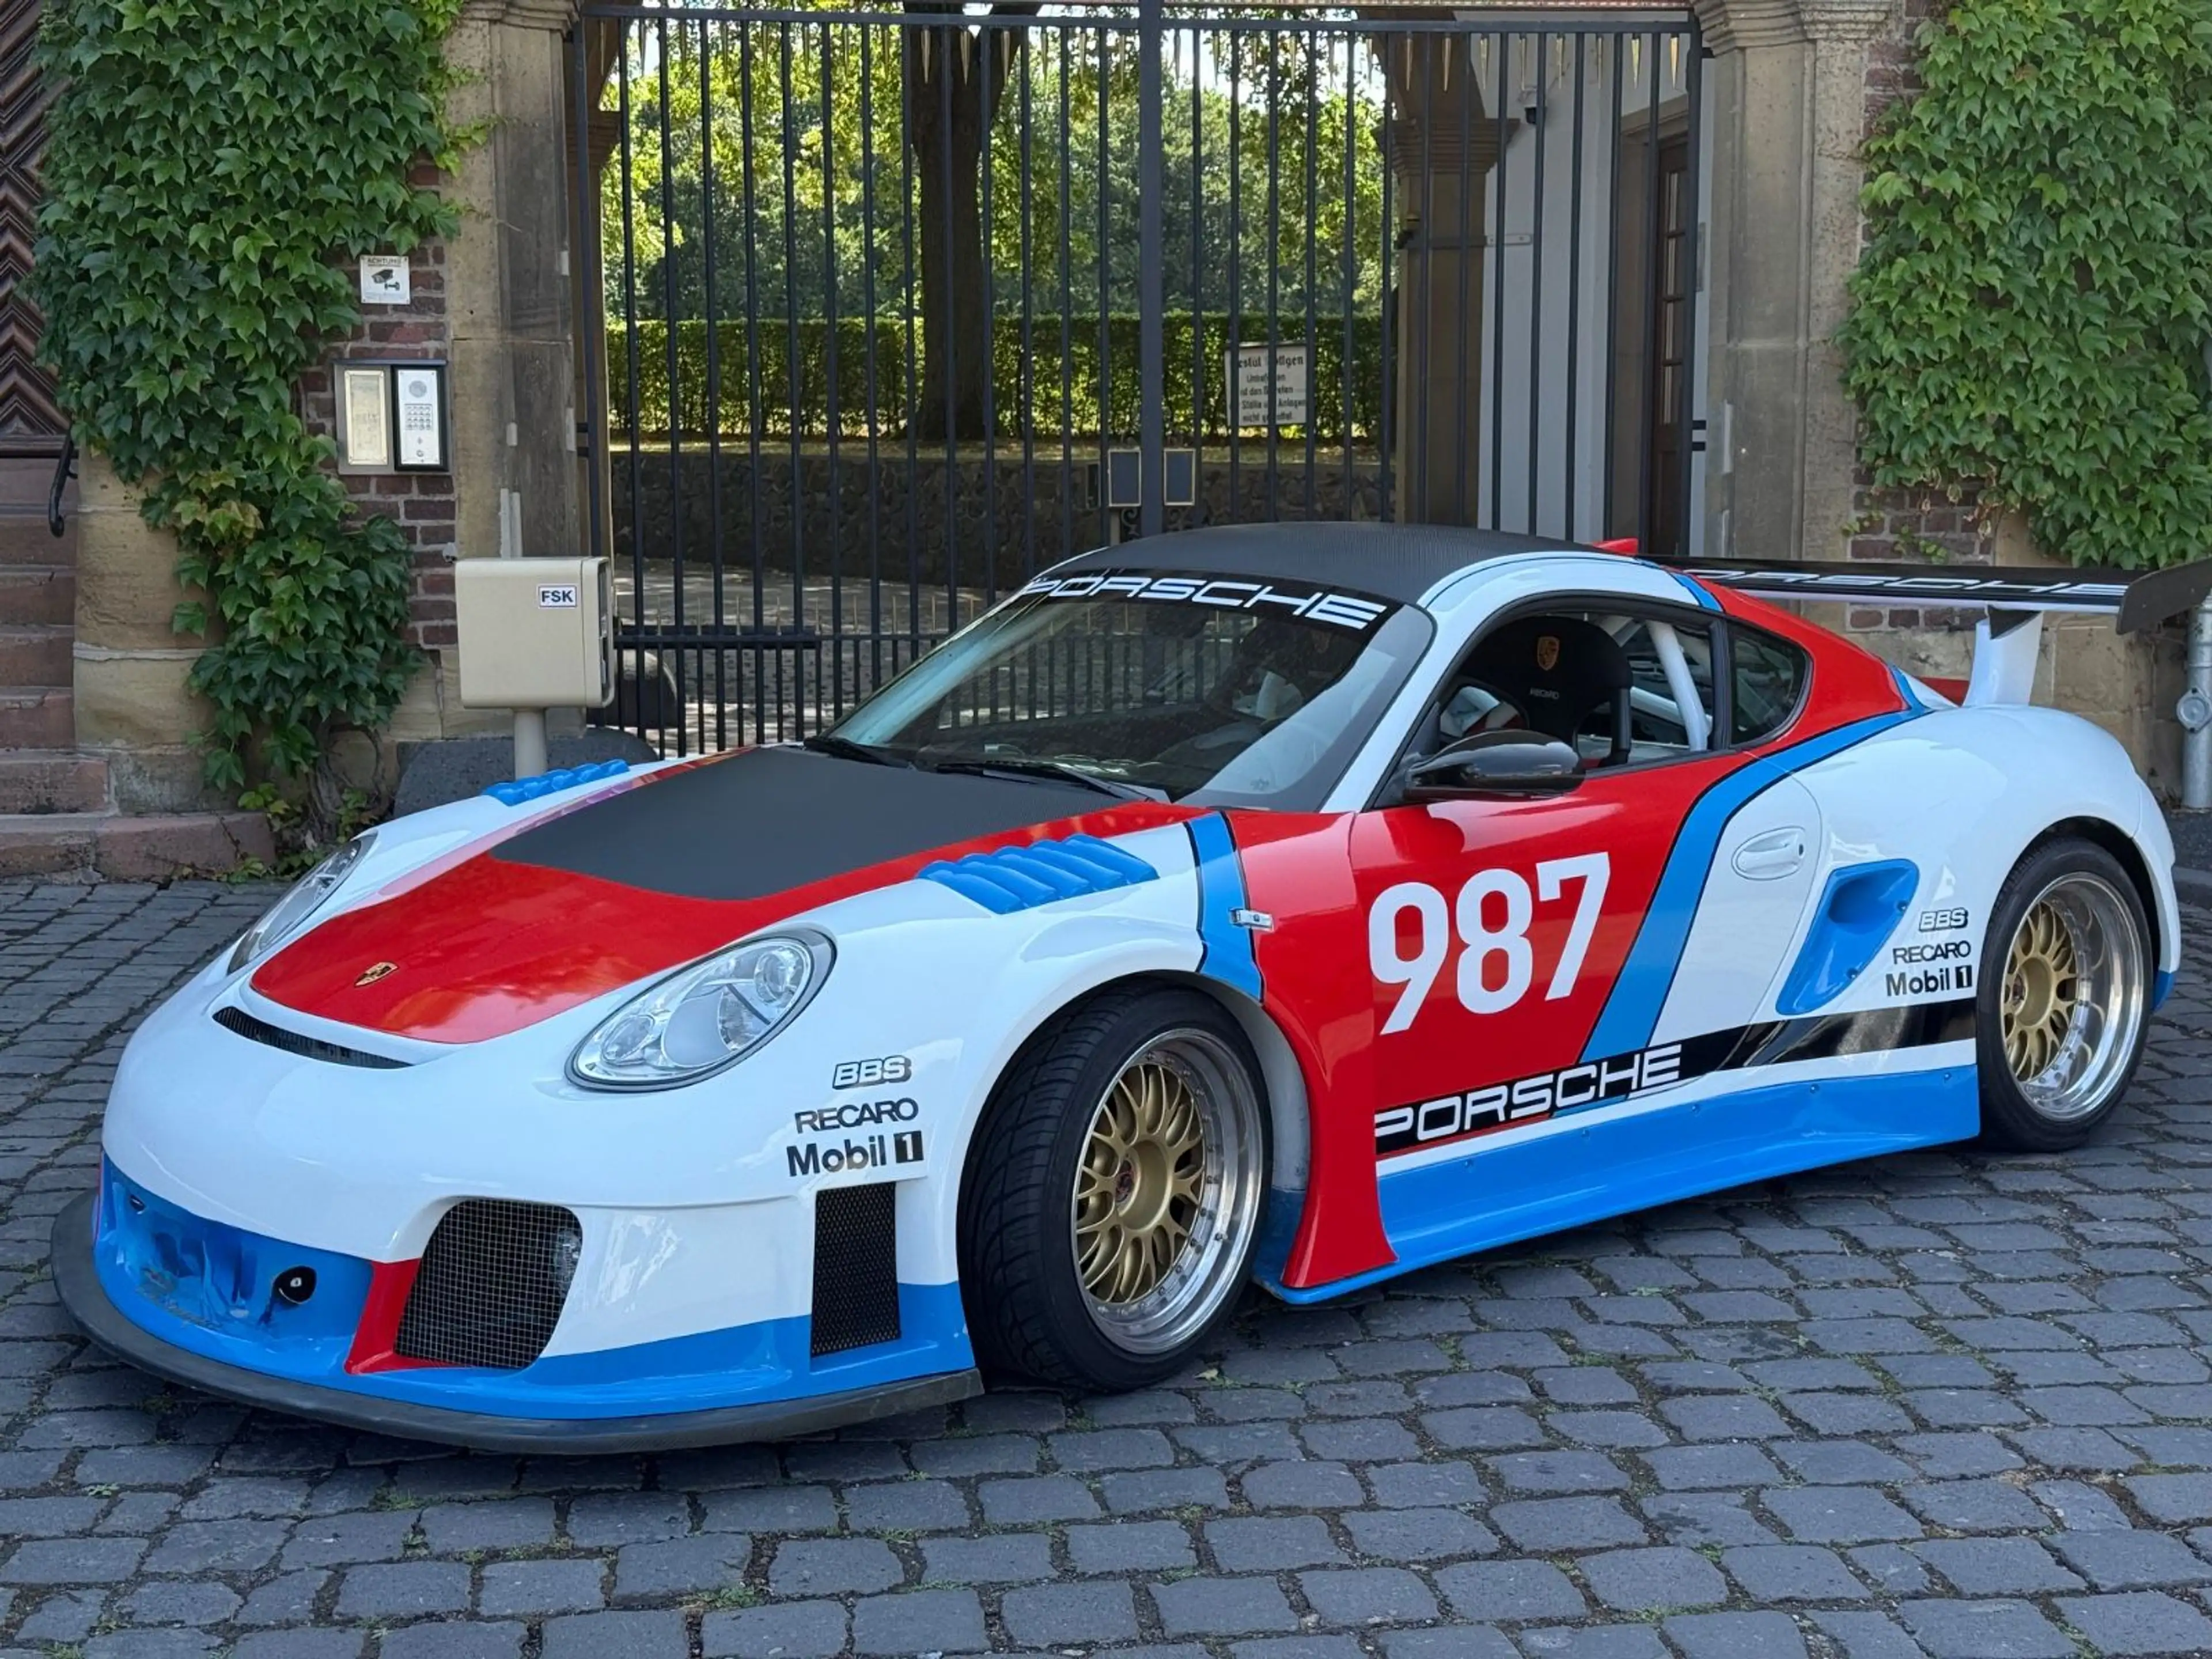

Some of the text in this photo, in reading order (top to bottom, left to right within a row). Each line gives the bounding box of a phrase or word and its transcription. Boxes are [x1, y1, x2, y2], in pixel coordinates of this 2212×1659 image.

[1238, 356, 1262, 368] estüt
[541, 590, 574, 603] FSK
[1683, 569, 2128, 596] ORSCHE
[1021, 576, 1387, 630] PORSCHE
[1919, 907, 1969, 932] BBS
[1369, 851, 1611, 1036] 987
[1892, 940, 1972, 964] RECARO
[1885, 967, 1950, 997] Mobil
[832, 1055, 912, 1089] BBS
[1375, 1044, 1681, 1142] PORSCHE
[794, 1097, 919, 1134] RECARO
[786, 1134, 887, 1177] Mobil
